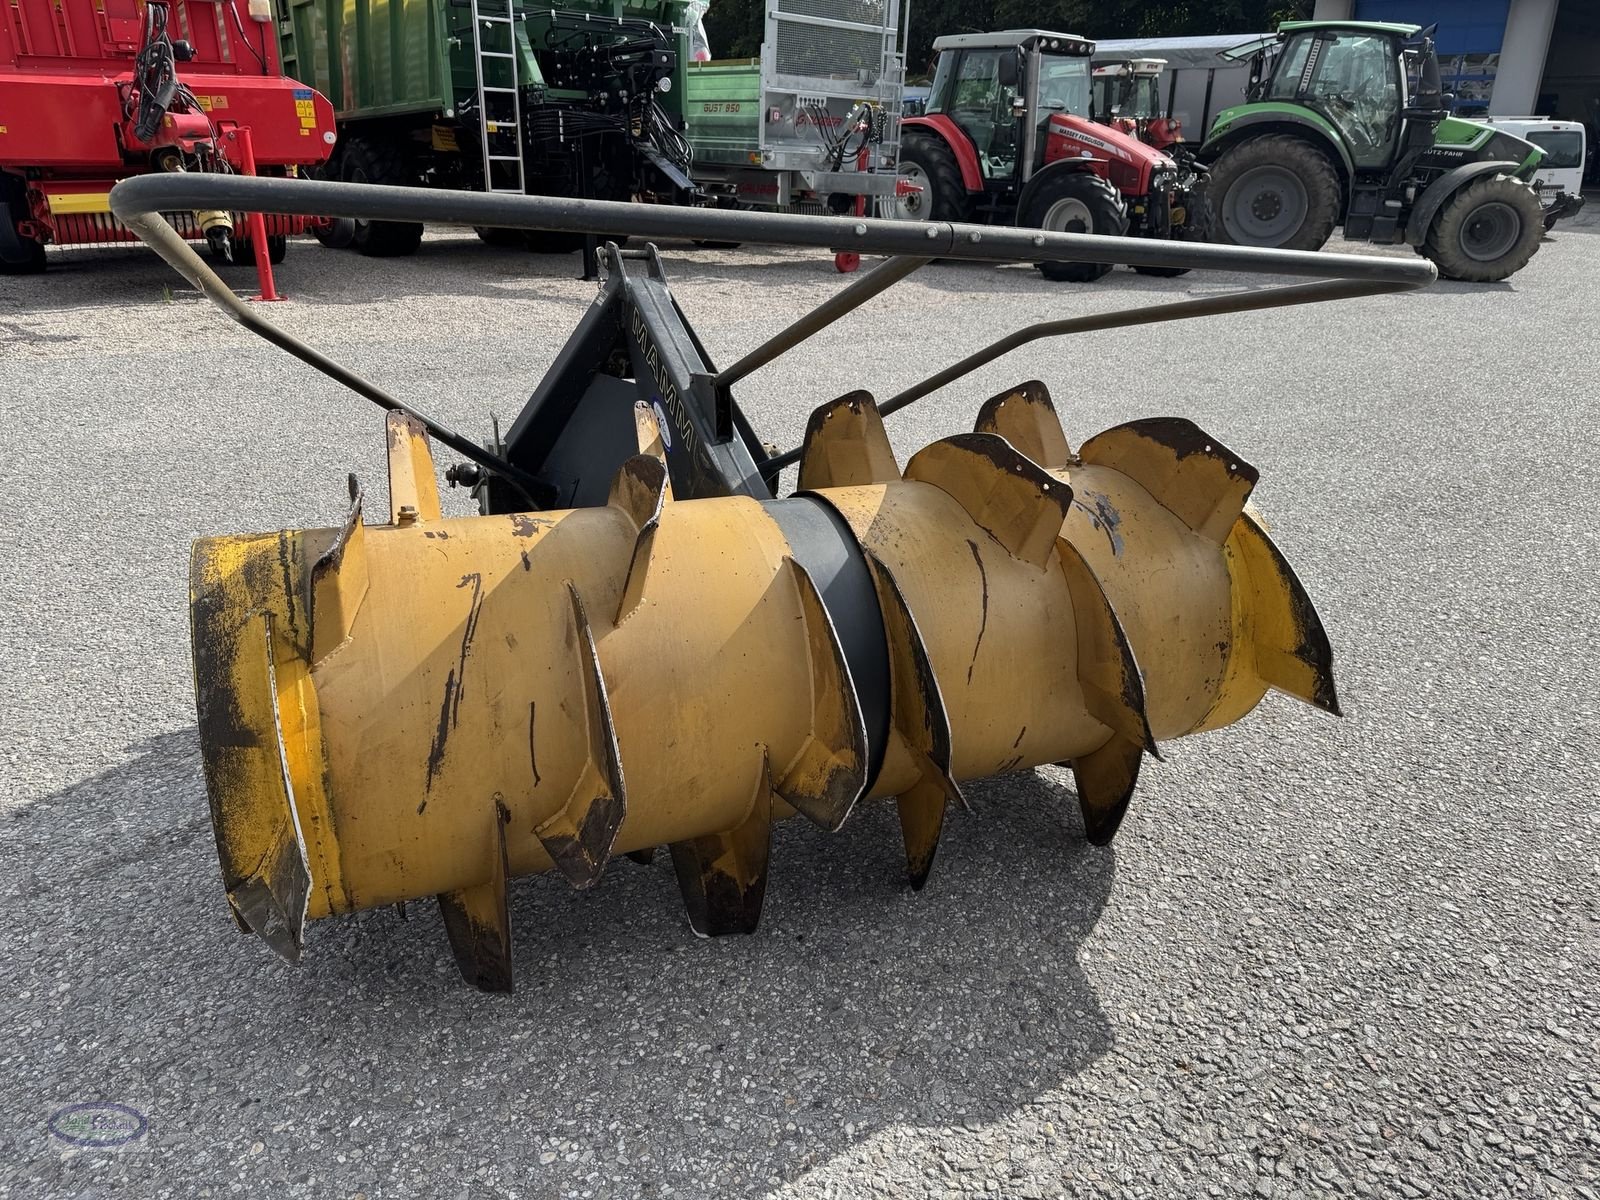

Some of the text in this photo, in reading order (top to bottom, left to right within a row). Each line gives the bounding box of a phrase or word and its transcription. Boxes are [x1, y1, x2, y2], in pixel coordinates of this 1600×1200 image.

[704, 103, 741, 113] GUST 850
[1059, 128, 1105, 148] MASSEY FERGUSON
